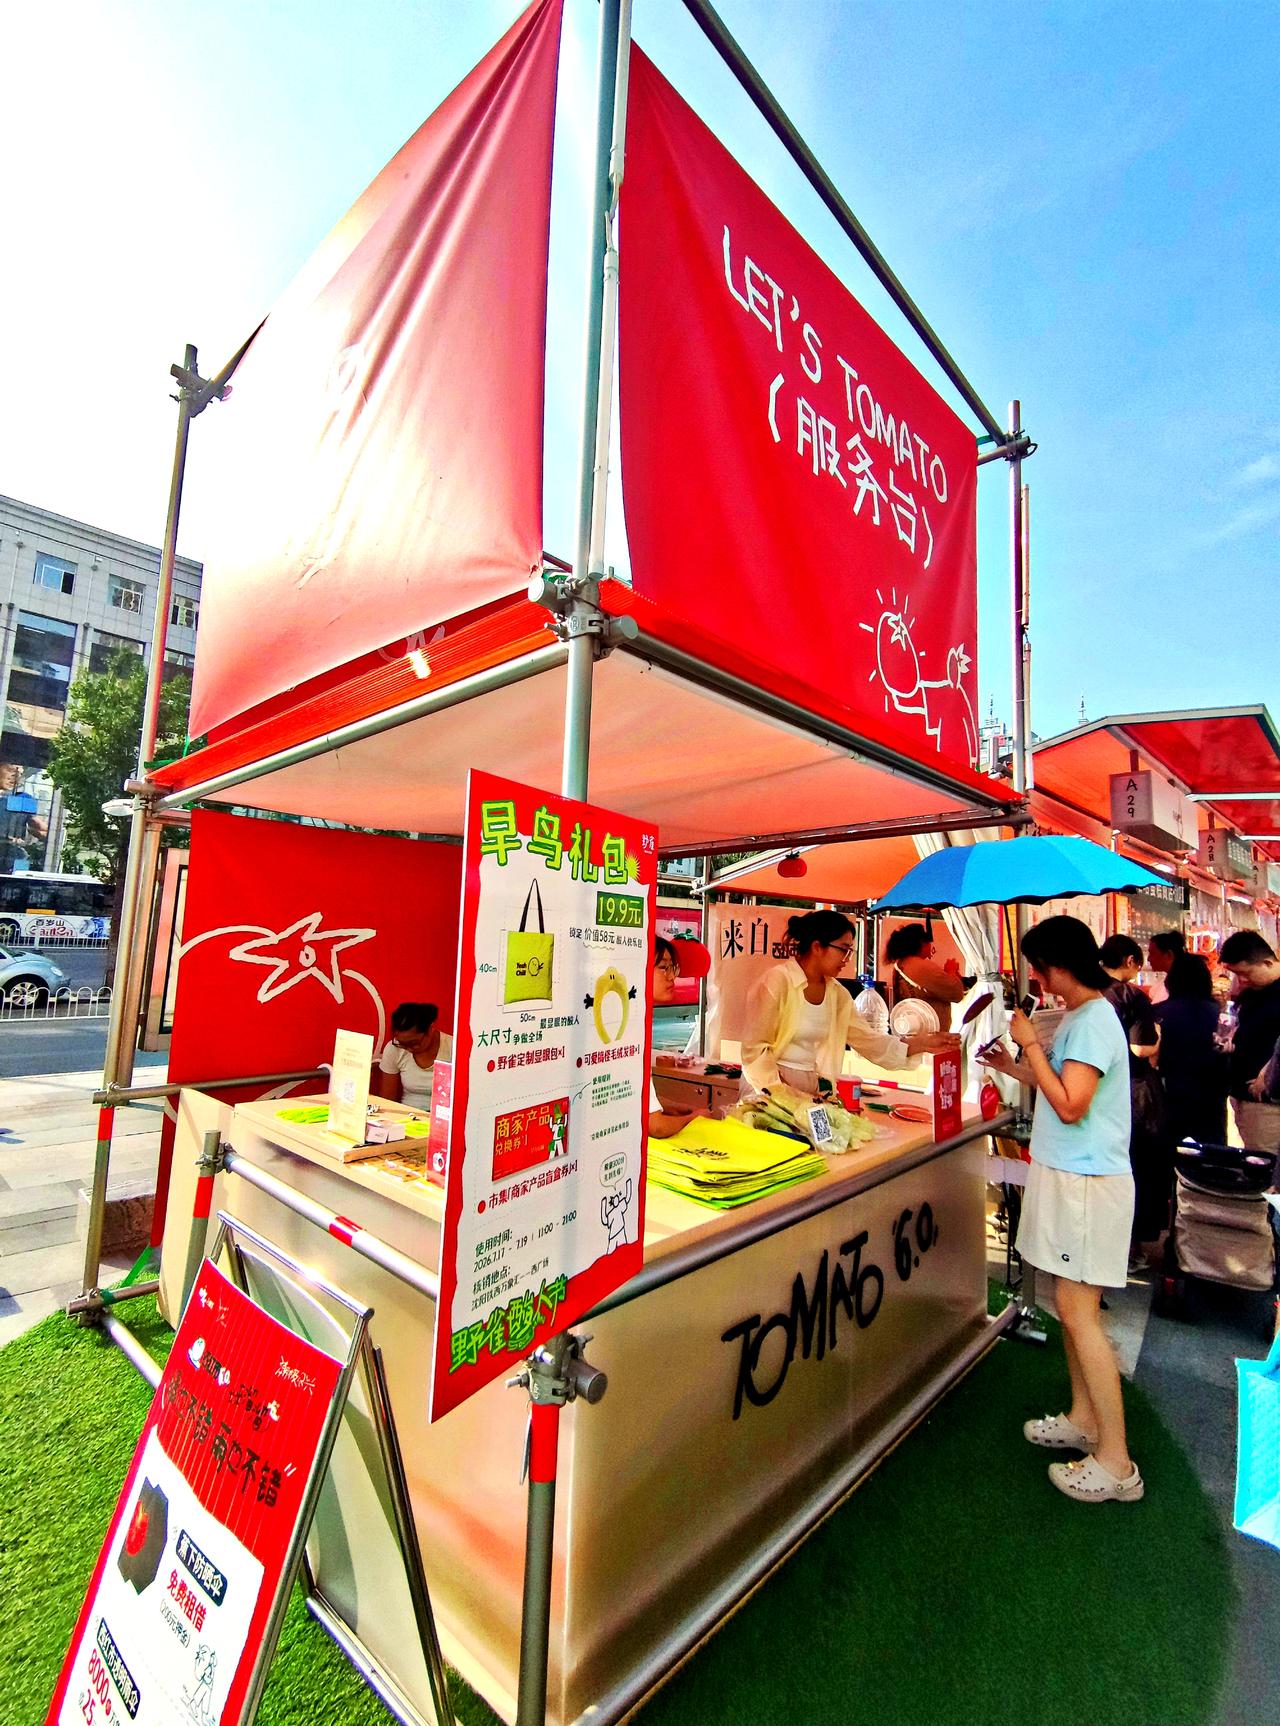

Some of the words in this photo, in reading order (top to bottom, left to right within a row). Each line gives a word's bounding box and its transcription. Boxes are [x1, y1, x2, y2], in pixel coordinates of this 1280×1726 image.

[723, 225, 822, 384] LET'S
[837, 354, 948, 504] TOMATO
[1126, 778, 1138, 818] A29
[481, 799, 628, 885] 早鸟礼包
[598, 896, 642, 925] 19.9元
[584, 927, 615, 944] 价值58元
[722, 917, 769, 958] 来自
[479, 963, 497, 973] 40cm
[477, 1027, 513, 1048] 大尺寸
[520, 1013, 536, 1023] 50cm
[496, 1105, 551, 1141] 商家产品
[448, 1273, 569, 1376] 野雀酸人节
[721, 1230, 885, 1421] TOMATO
[166, 1568, 207, 1633] 免费租借
[88, 1648, 109, 1705] 8000
